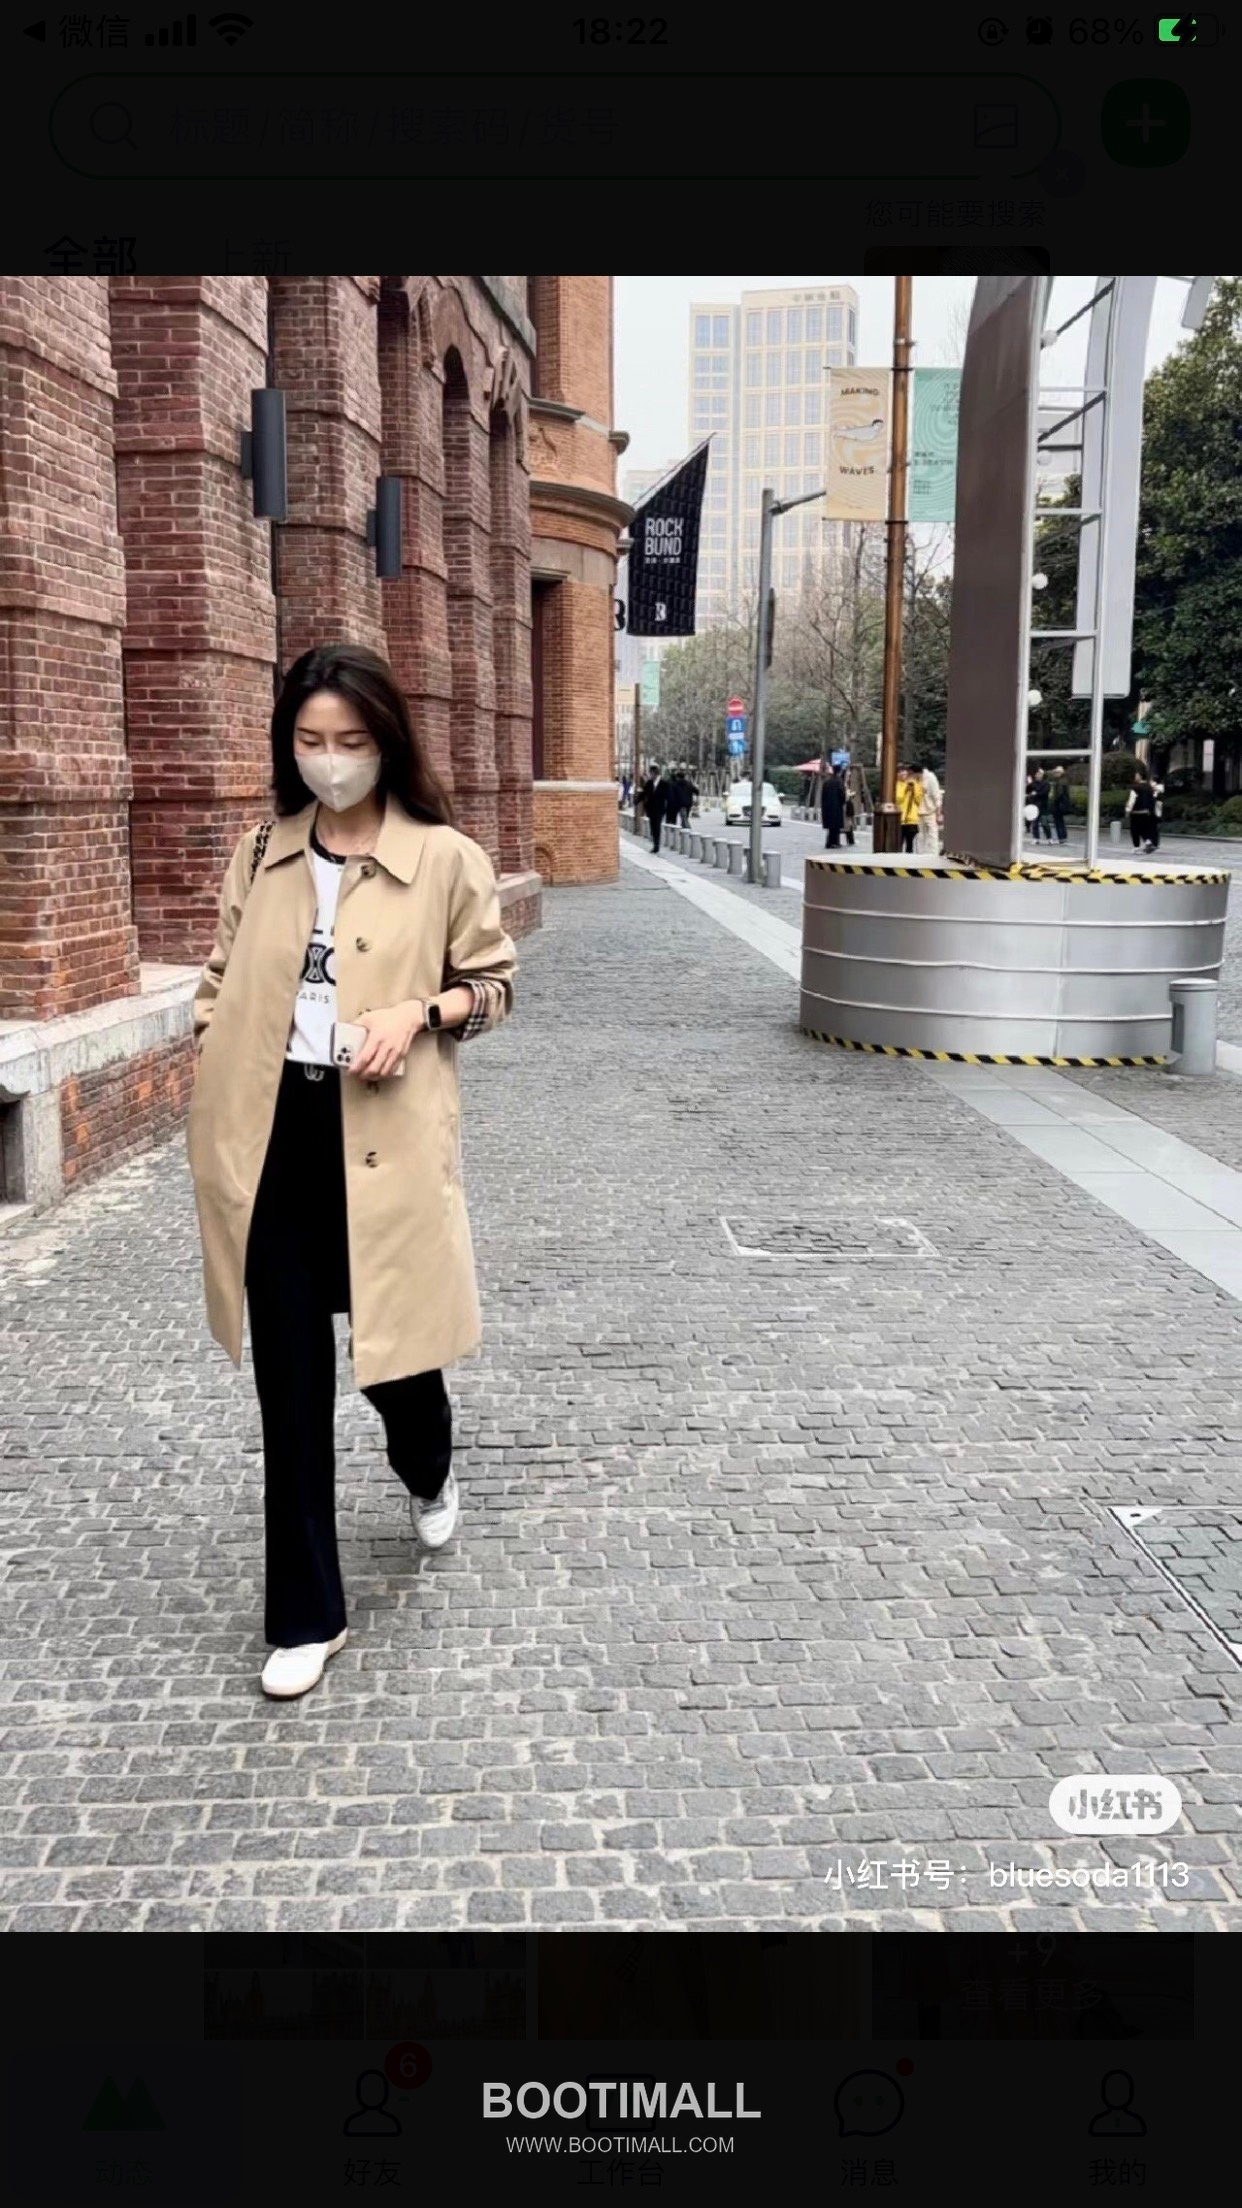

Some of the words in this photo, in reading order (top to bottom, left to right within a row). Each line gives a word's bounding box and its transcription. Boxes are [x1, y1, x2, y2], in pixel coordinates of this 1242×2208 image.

[841, 387, 879, 396] MAKING
[839, 466, 875, 475] WAVES
[645, 517, 684, 537] ROCK
[644, 536, 682, 556] BUND
[296, 991, 330, 1004] ARIS
